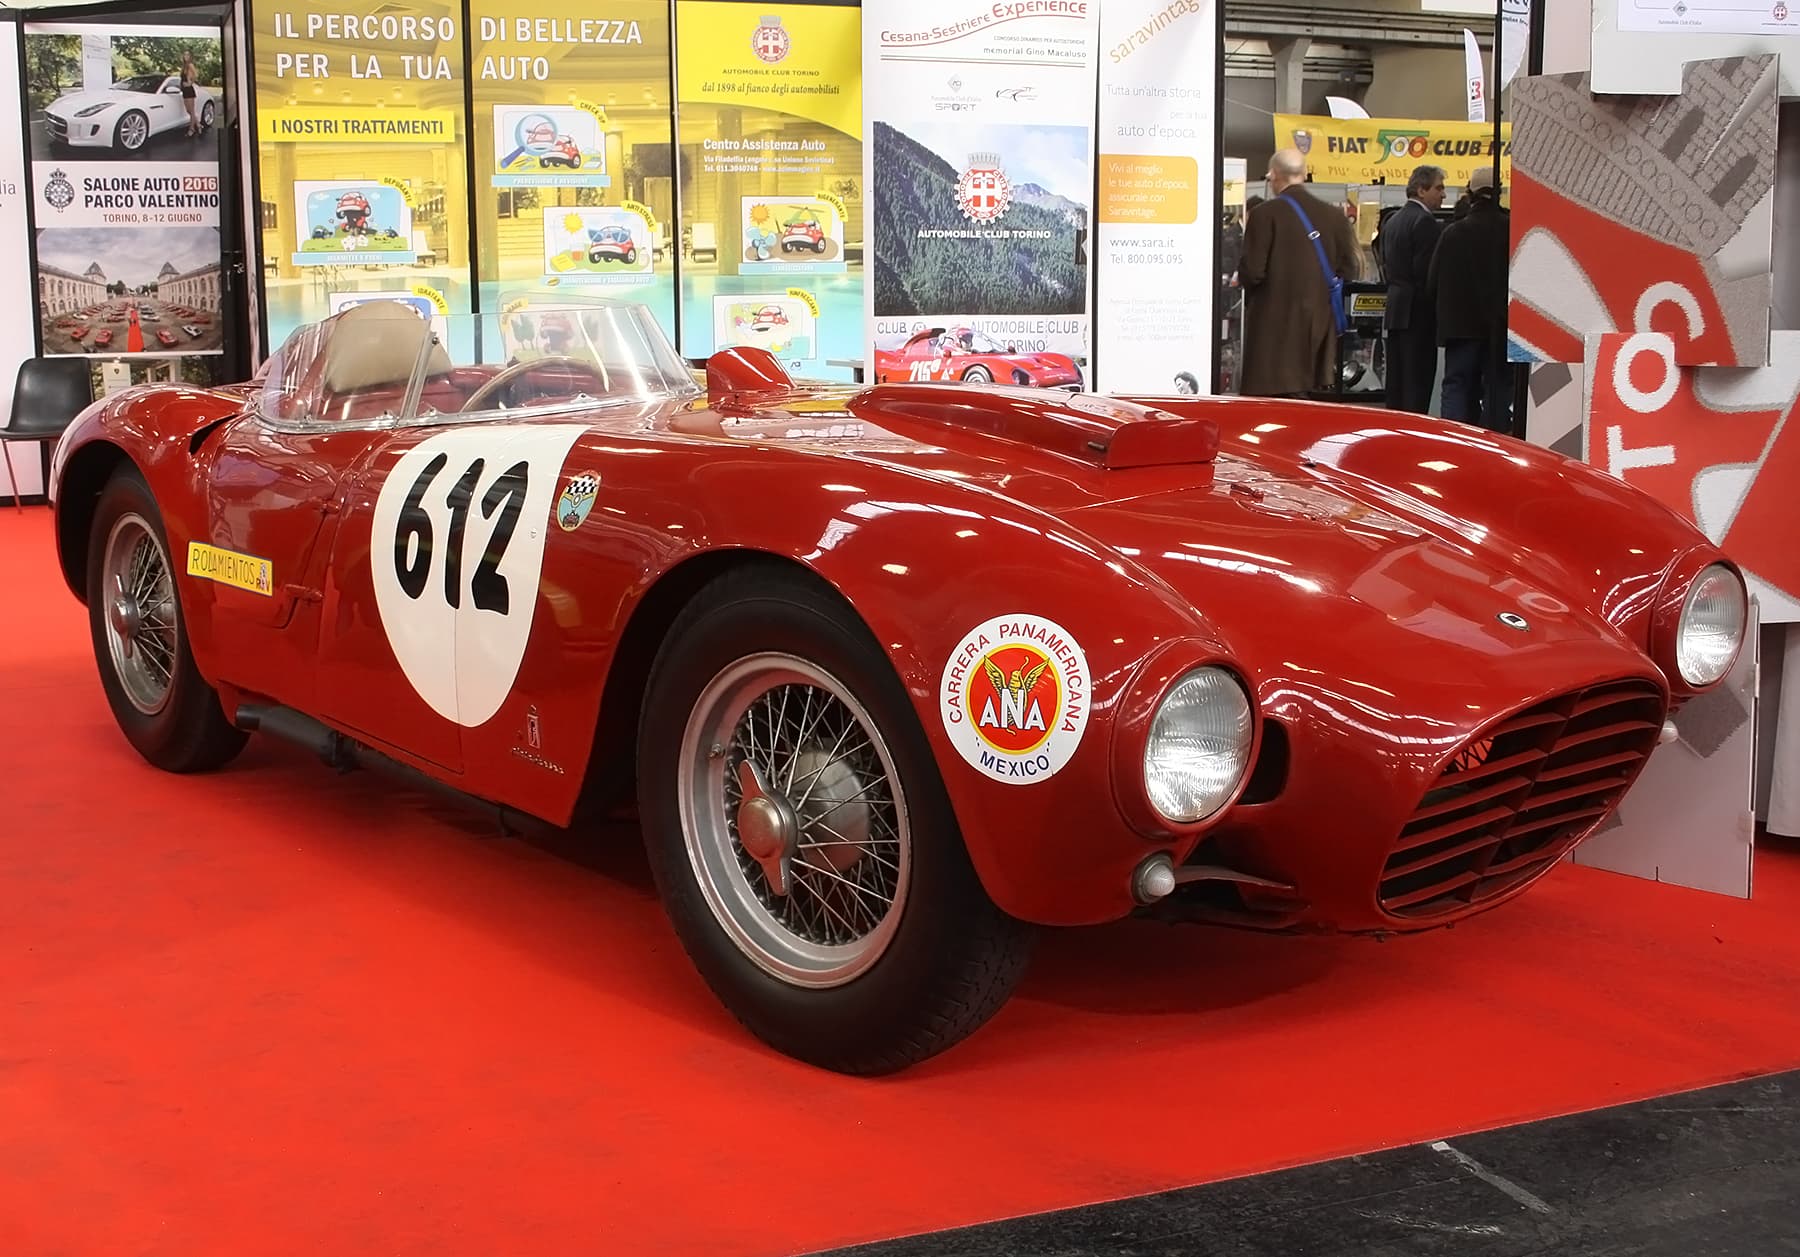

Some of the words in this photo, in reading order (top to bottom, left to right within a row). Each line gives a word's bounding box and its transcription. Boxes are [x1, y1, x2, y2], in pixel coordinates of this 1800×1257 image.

[274, 13, 299, 39] IL
[307, 14, 456, 41] PERCORSO
[881, 13, 990, 43] Cesana-Sestriere
[992, 0, 1088, 18] Experience
[480, 17, 506, 42] DI
[515, 18, 643, 45] BELLEZZA
[983, 47, 1024, 55] memorial
[1025, 48, 1045, 56] Gino
[1047, 49, 1087, 58] Macaluso
[276, 53, 330, 79] PER
[350, 54, 383, 80] LA
[400, 55, 453, 81] TUA
[480, 55, 550, 81] AUTO
[722, 68, 770, 76] AUTOMOBILE
[702, 82, 715, 93] dal
[717, 82, 736, 93] 1898
[737, 82, 745, 93] al
[746, 83, 770, 95] fianco
[771, 83, 790, 96] degli
[791, 84, 841, 96] automobilisti
[272, 119, 278, 134] I
[281, 119, 339, 134] NOSTRI
[342, 119, 443, 135] TRATTAMENTI
[1117, 125, 1145, 138] auto
[703, 138, 740, 151] Centro
[741, 139, 799, 151] Assistenza
[800, 139, 826, 151] Auto
[1327, 135, 1369, 154] FIAT
[1374, 129, 1430, 165] 500
[1433, 139, 1482, 157] CLUB
[1361, 167, 1409, 179] GRANDE
[84, 177, 140, 192] SALONE
[143, 177, 180, 192] AUTO
[184, 177, 217, 191] 2016
[85, 195, 133, 209] PARCO
[139, 194, 219, 209] VALENTINO
[103, 213, 141, 225] TORINO,
[143, 213, 165, 223] 8-12
[168, 213, 202, 223] GIUGNO
[917, 230, 981, 240] AUTOMOBILE
[984, 230, 1010, 239] CLUB
[1012, 230, 1051, 240] TORINO
[1109, 236, 1175, 248] www.sara.it
[1127, 254, 1184, 265] 800.095.095
[877, 321, 907, 334] CLUB
[971, 320, 1044, 334] AUTOMOBILE
[1047, 320, 1079, 334] CLUB
[394, 452, 529, 617] 612
[948, 633, 991, 724] CARRERA
[999, 622, 1083, 734] PANAMERICANA
[978, 687, 1047, 731] ANA
[979, 750, 1050, 777] MEXICO
